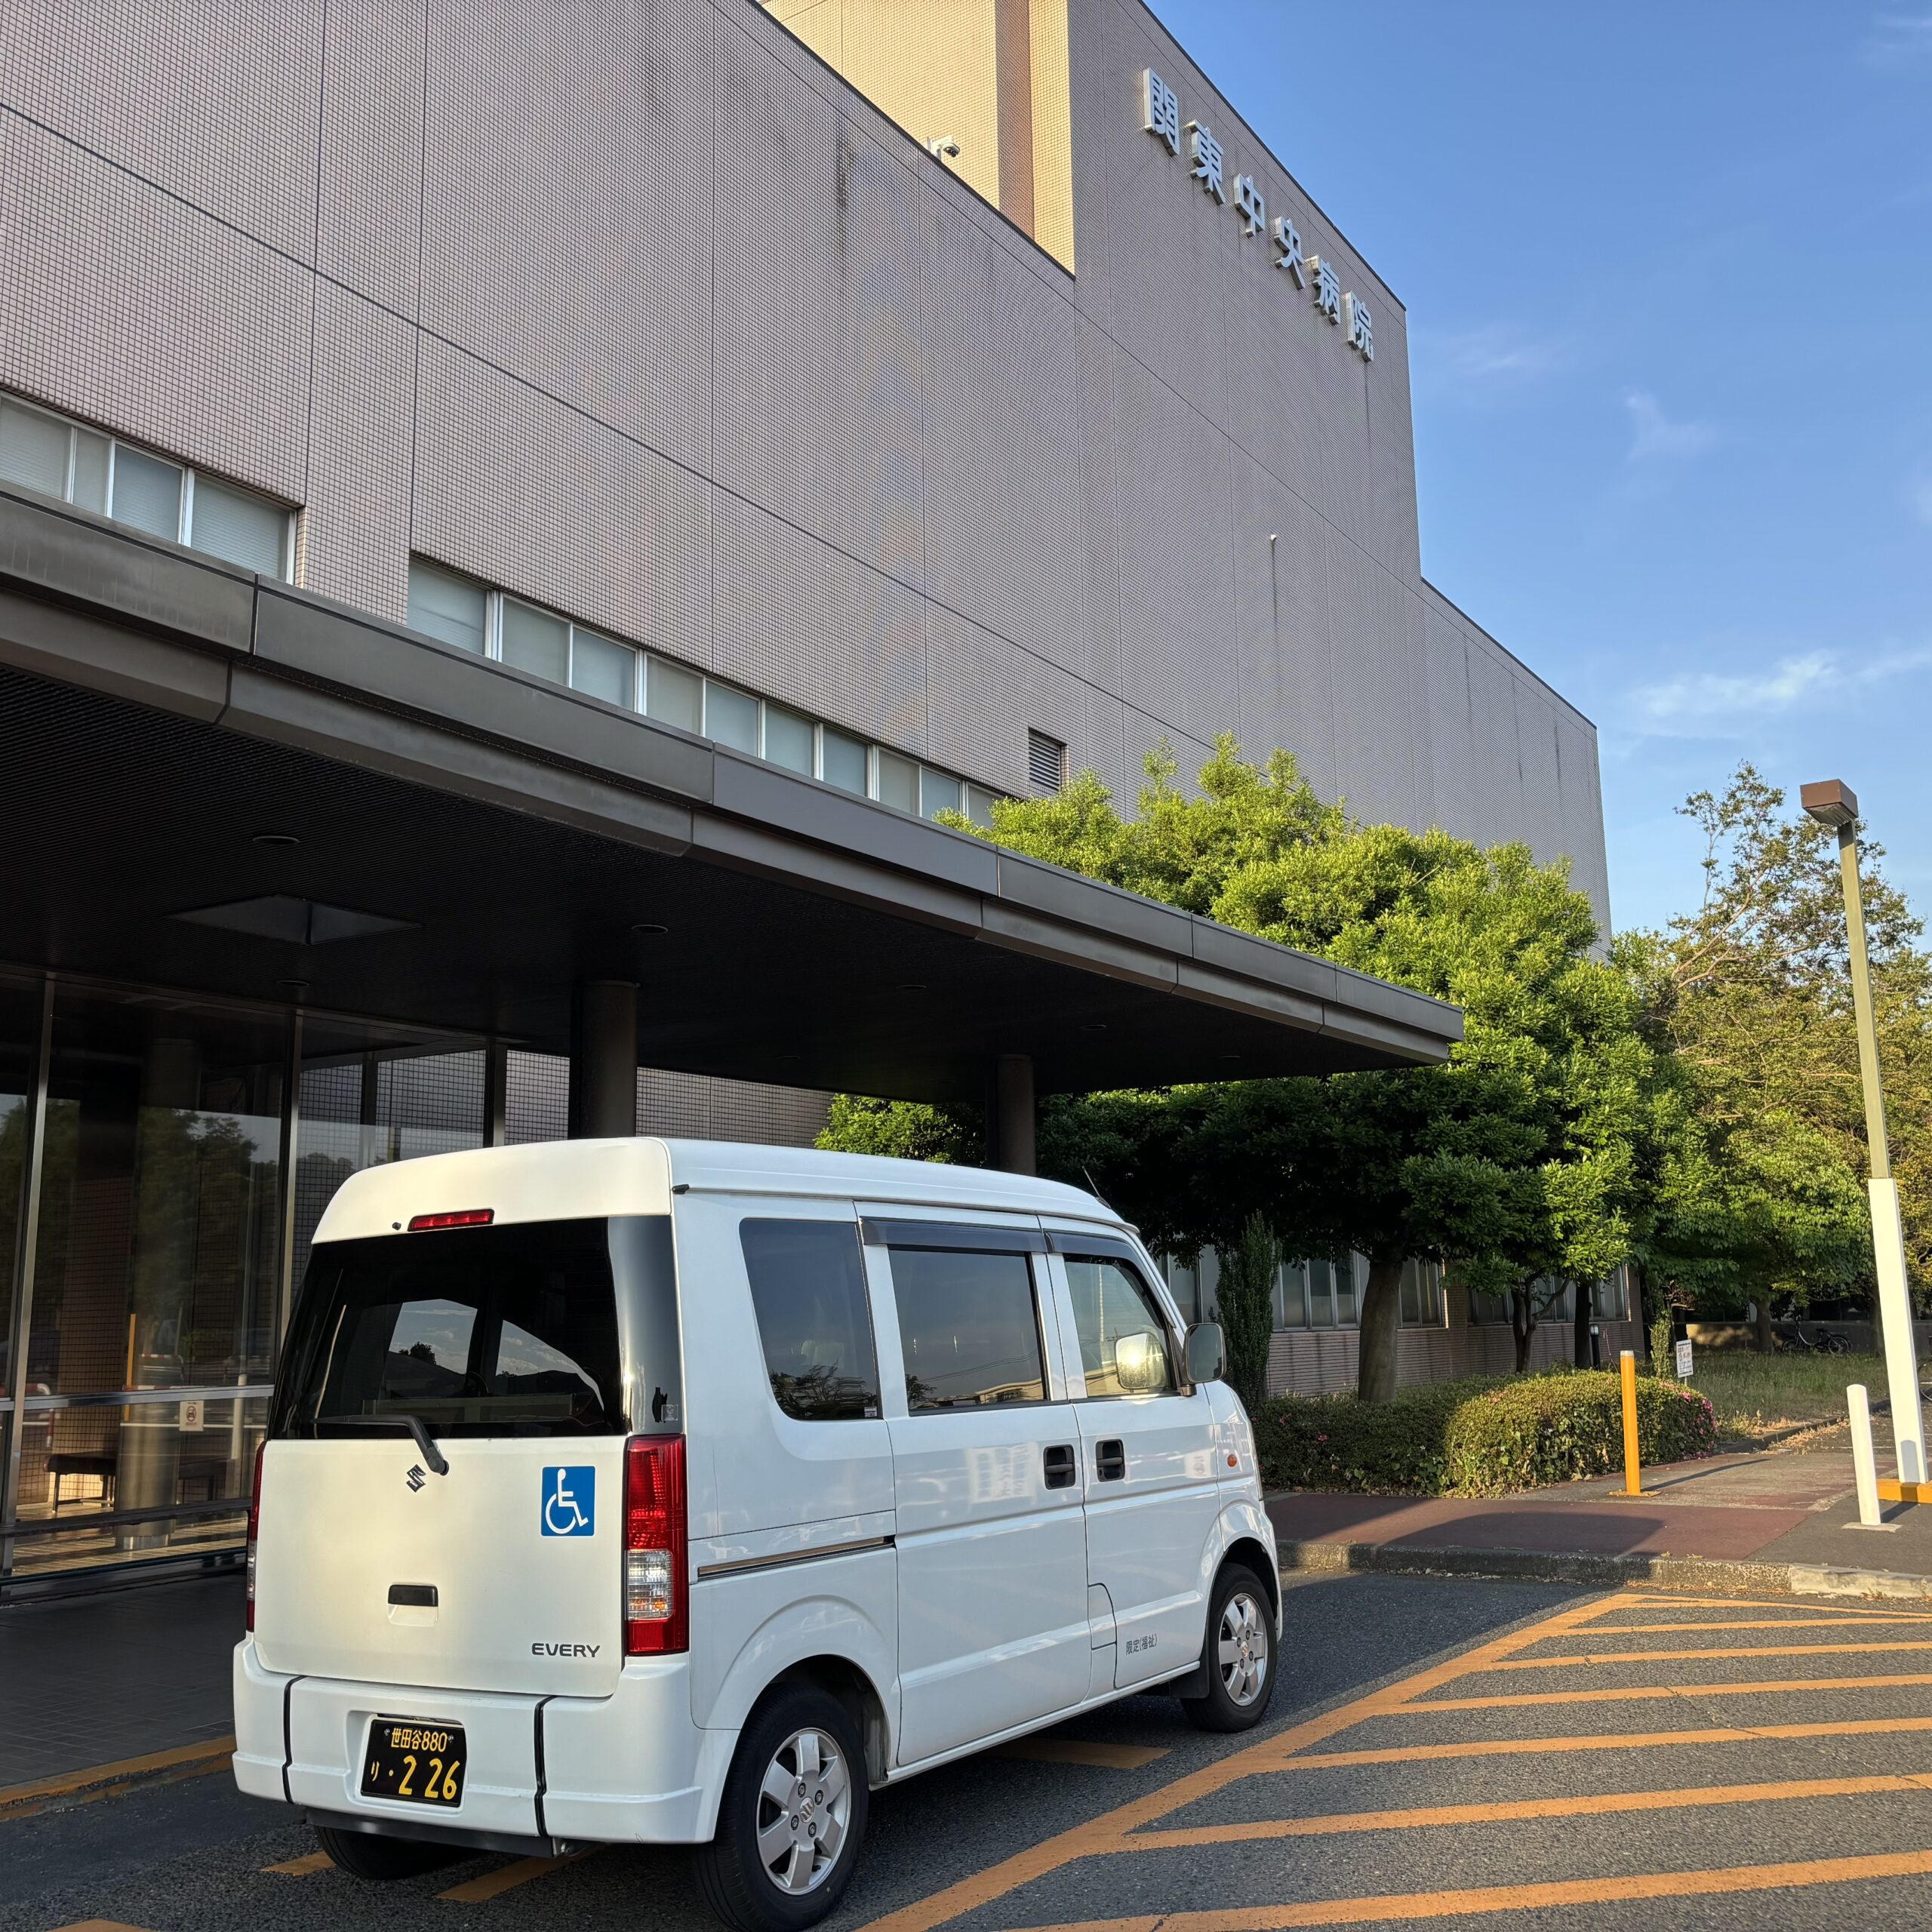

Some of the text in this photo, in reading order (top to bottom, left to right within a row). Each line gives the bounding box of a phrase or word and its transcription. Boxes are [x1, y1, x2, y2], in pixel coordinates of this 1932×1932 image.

[1142, 67, 1374, 362] 関東中央病院
[531, 1642, 601, 1658] EVERY
[391, 1727, 448, 1753] 世田谷880
